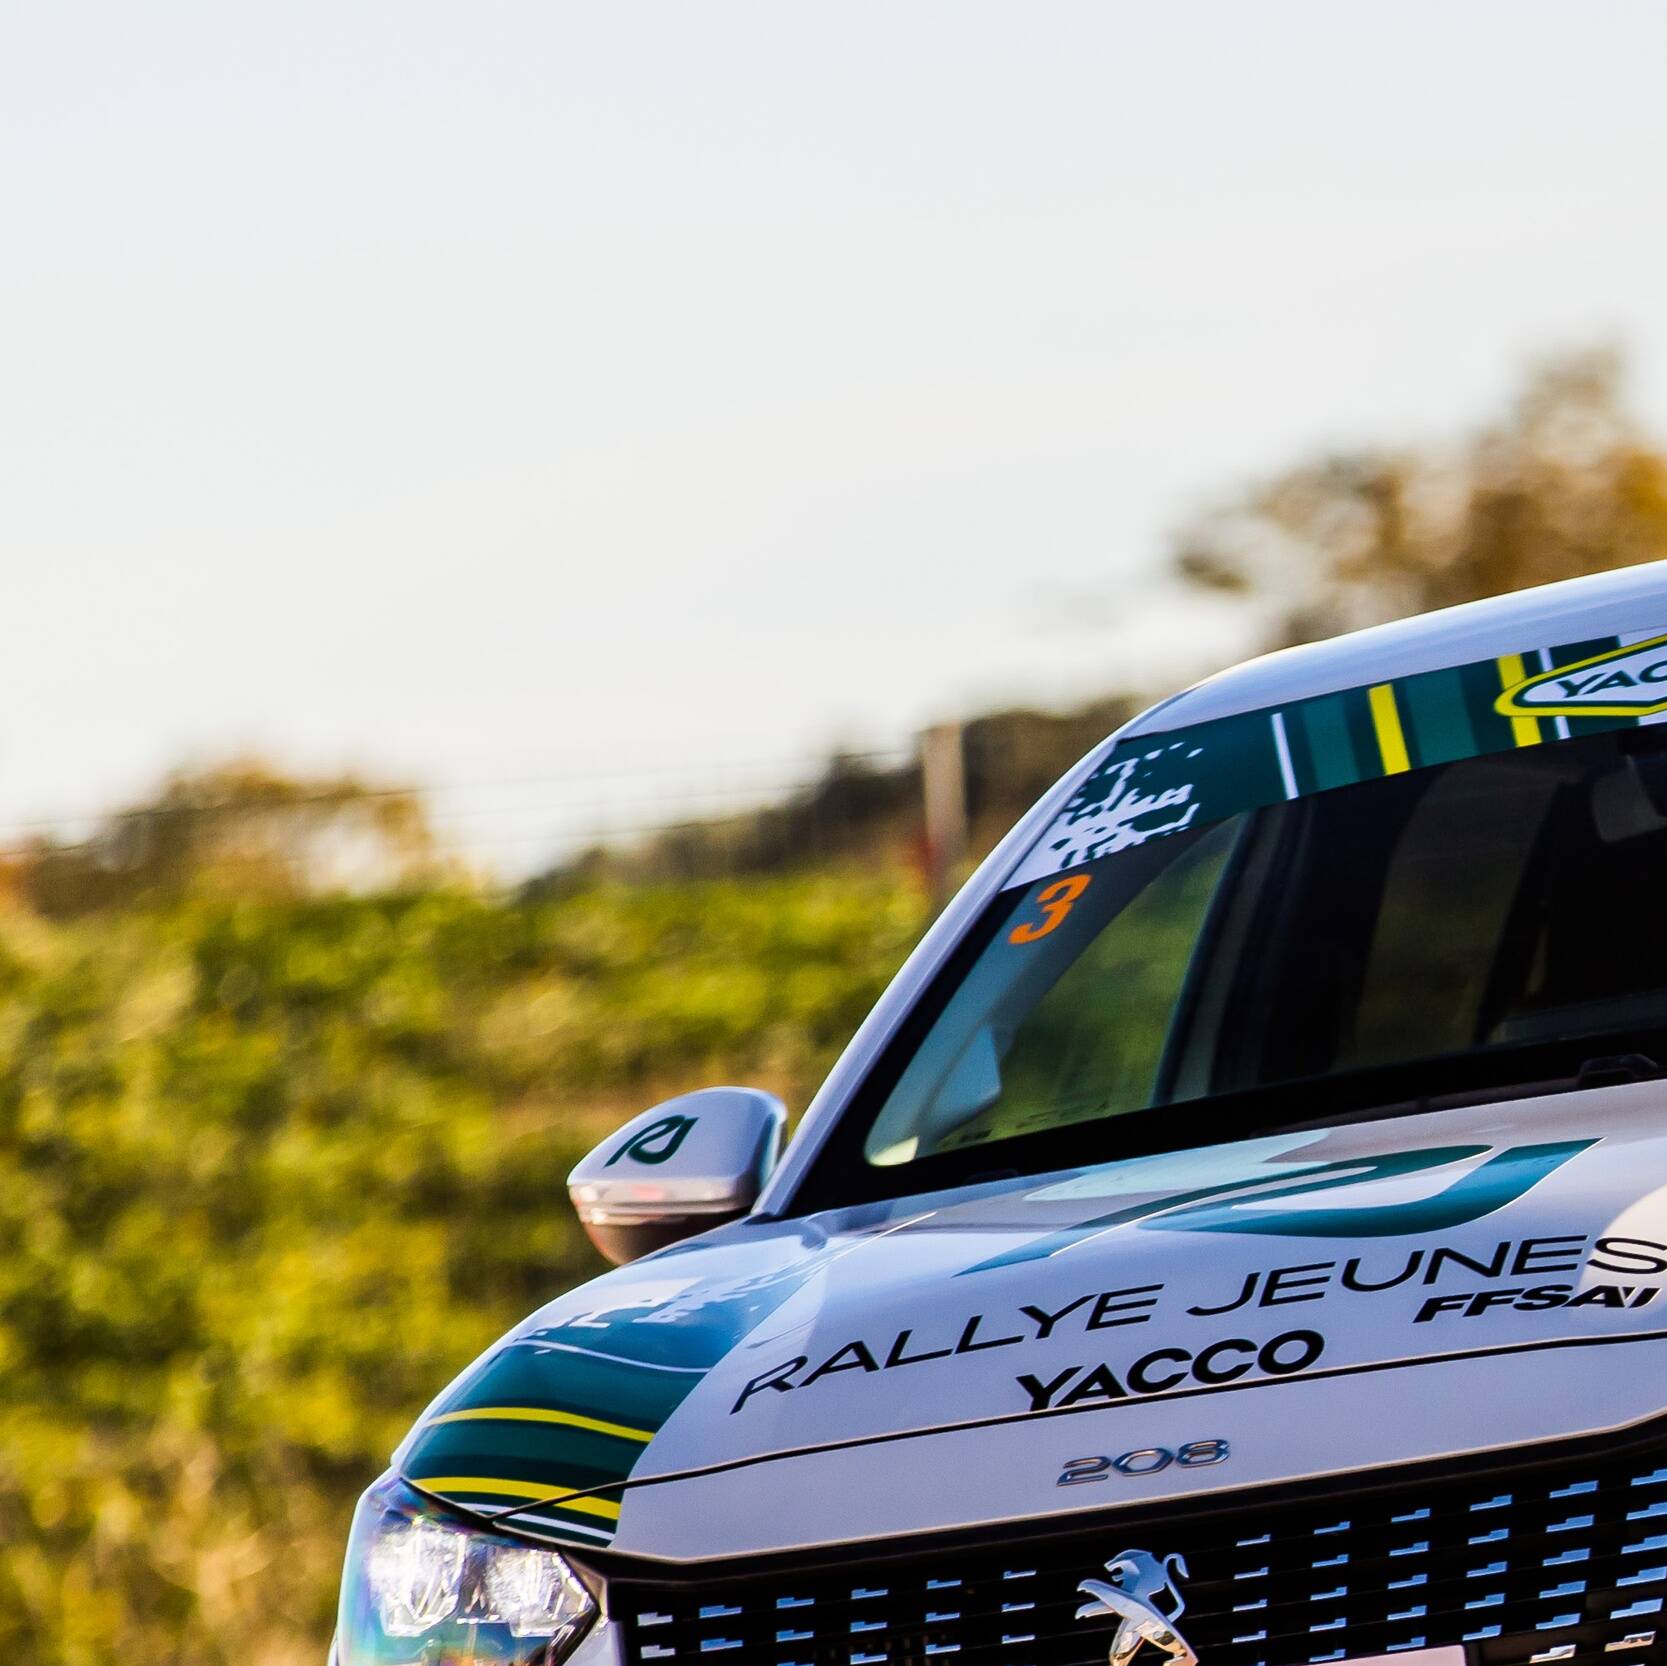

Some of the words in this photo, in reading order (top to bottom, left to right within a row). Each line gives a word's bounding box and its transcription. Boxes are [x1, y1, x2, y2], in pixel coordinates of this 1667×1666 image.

[1009, 874, 1092, 944] 3
[1412, 1285, 1640, 1325] FFSA
[729, 1281, 1165, 1415] RALLYE
[1015, 1328, 1326, 1412] YACCO
[1055, 1438, 1233, 1487] 208
